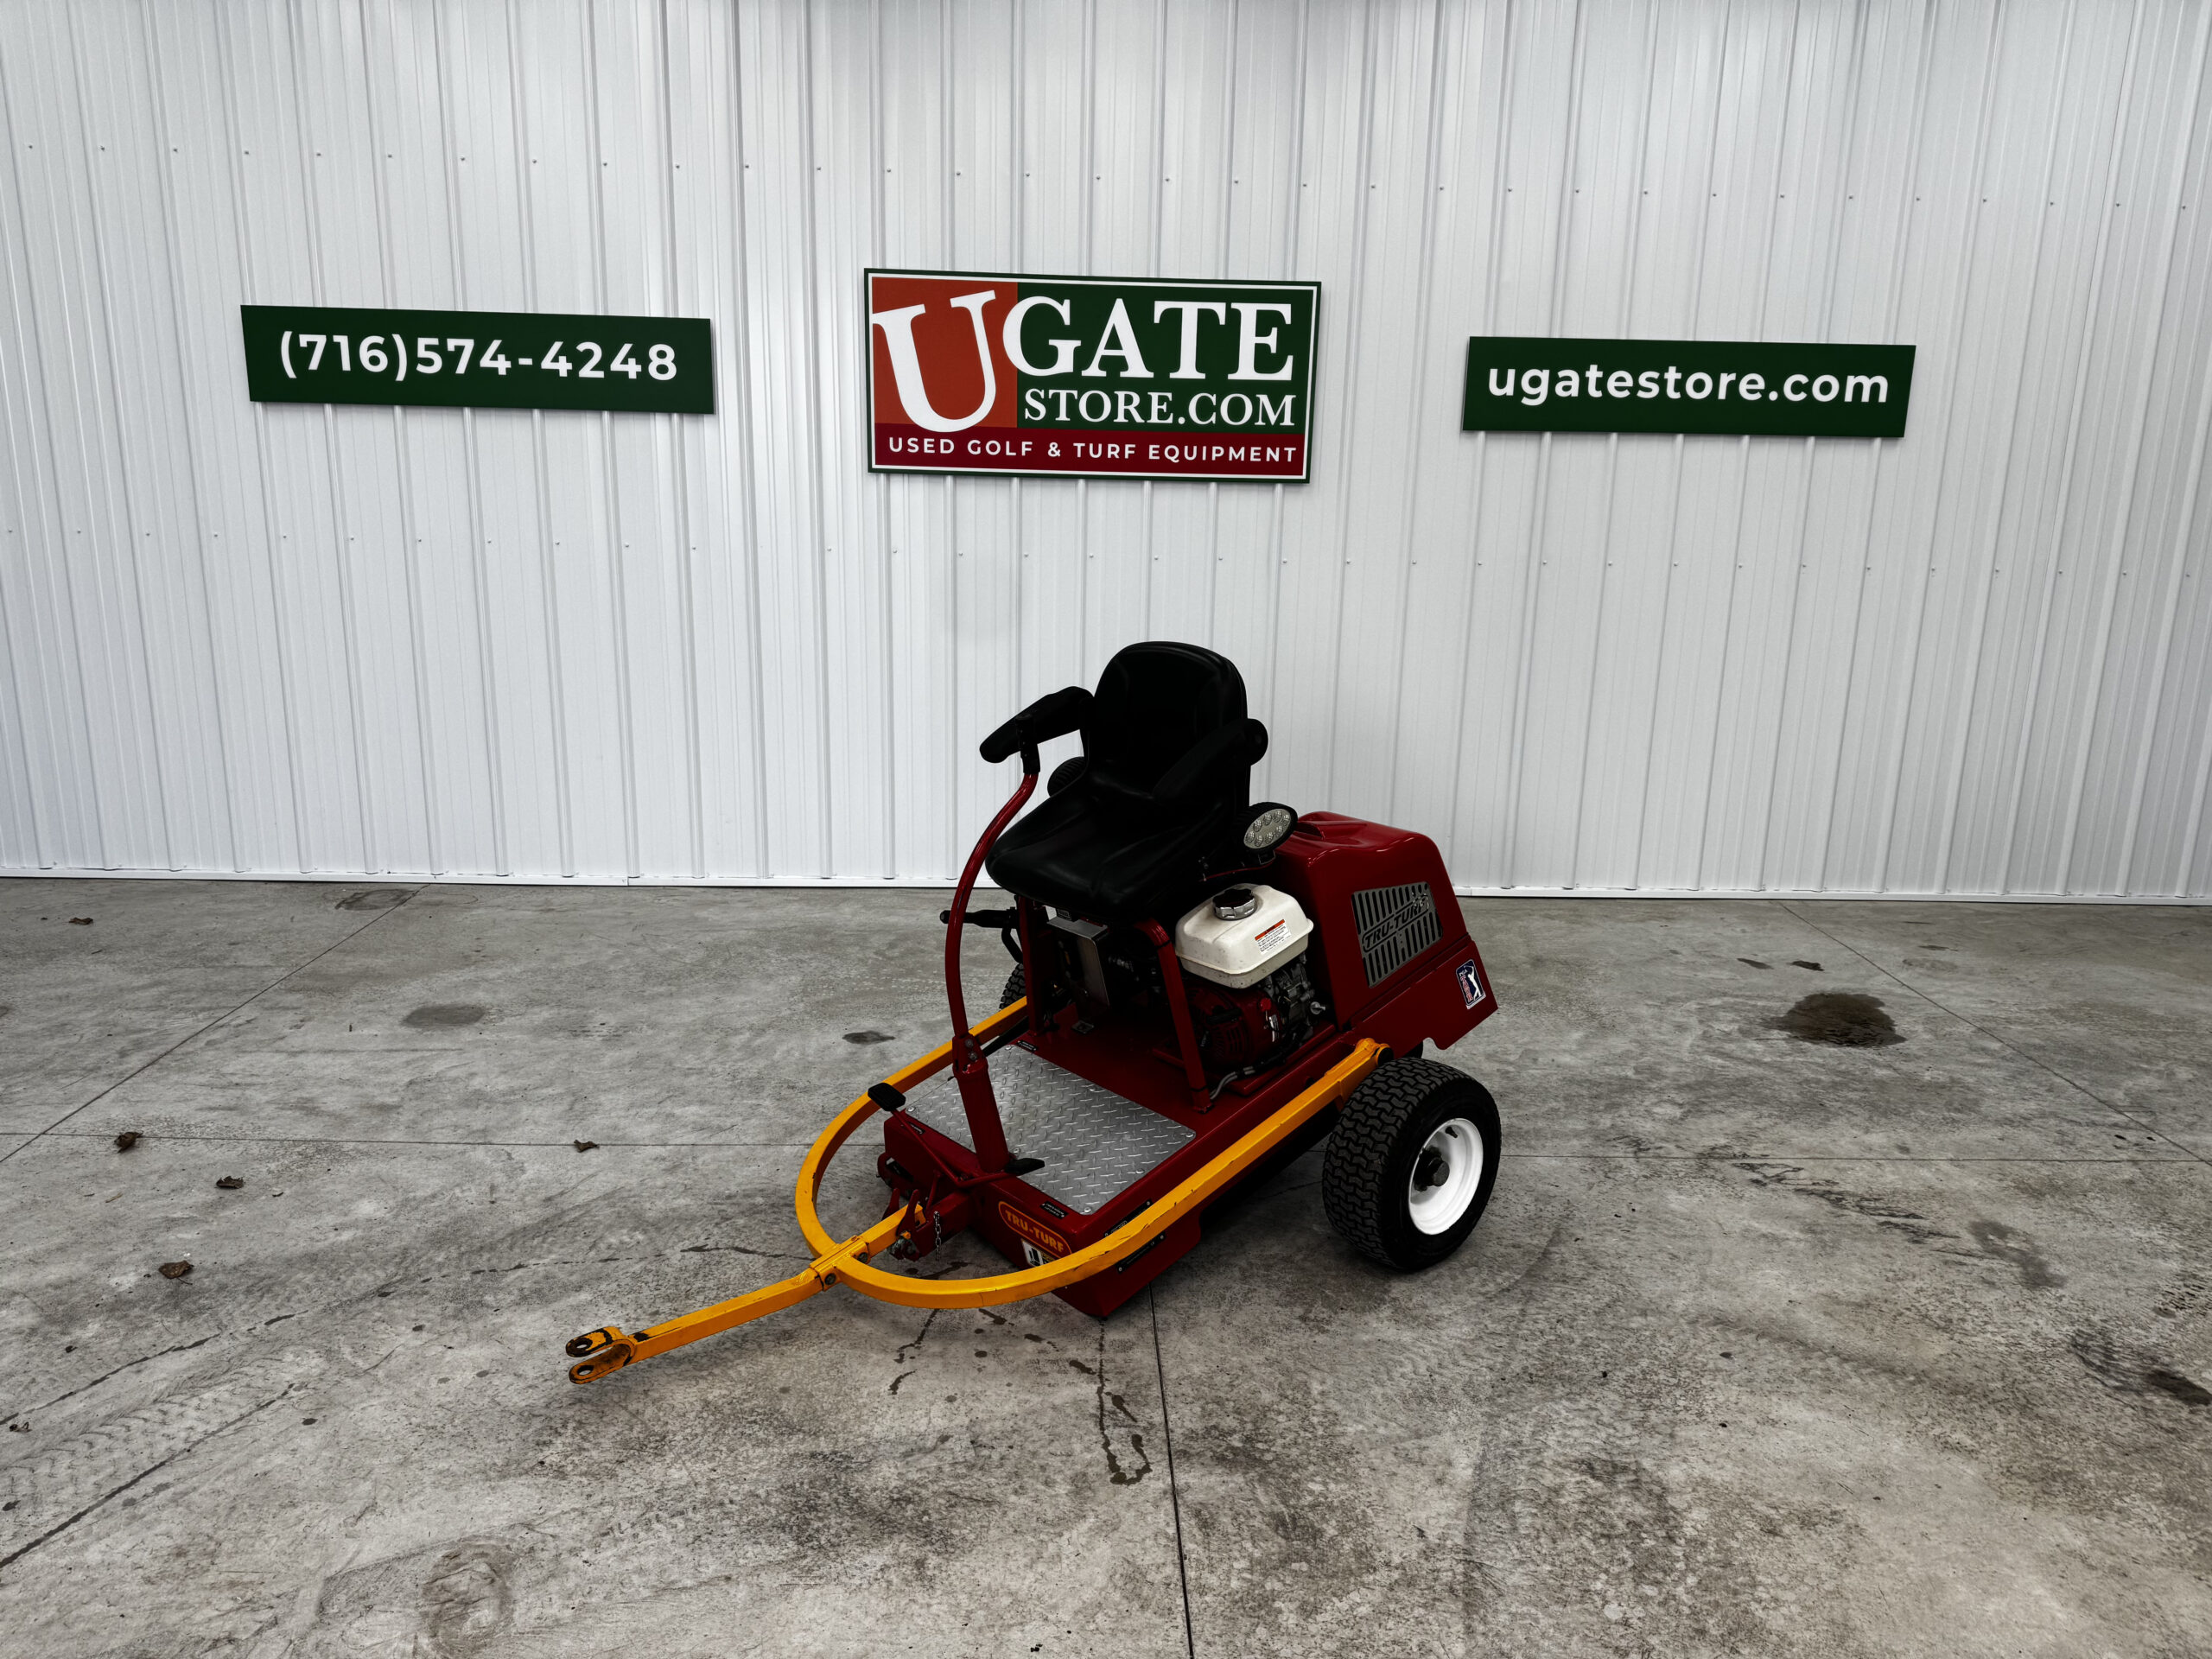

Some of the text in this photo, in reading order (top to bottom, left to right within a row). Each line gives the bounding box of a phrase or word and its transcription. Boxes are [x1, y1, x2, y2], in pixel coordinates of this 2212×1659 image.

[281, 330, 678, 382] (716)574-4248
[1488, 364, 1890, 406] ugatestore.com
[1024, 388, 1297, 426] STORE.COM
[888, 436, 1298, 463] USED GOLF & TURF EQUIPMENT
[1004, 1209, 1065, 1253] TRU-TURF
